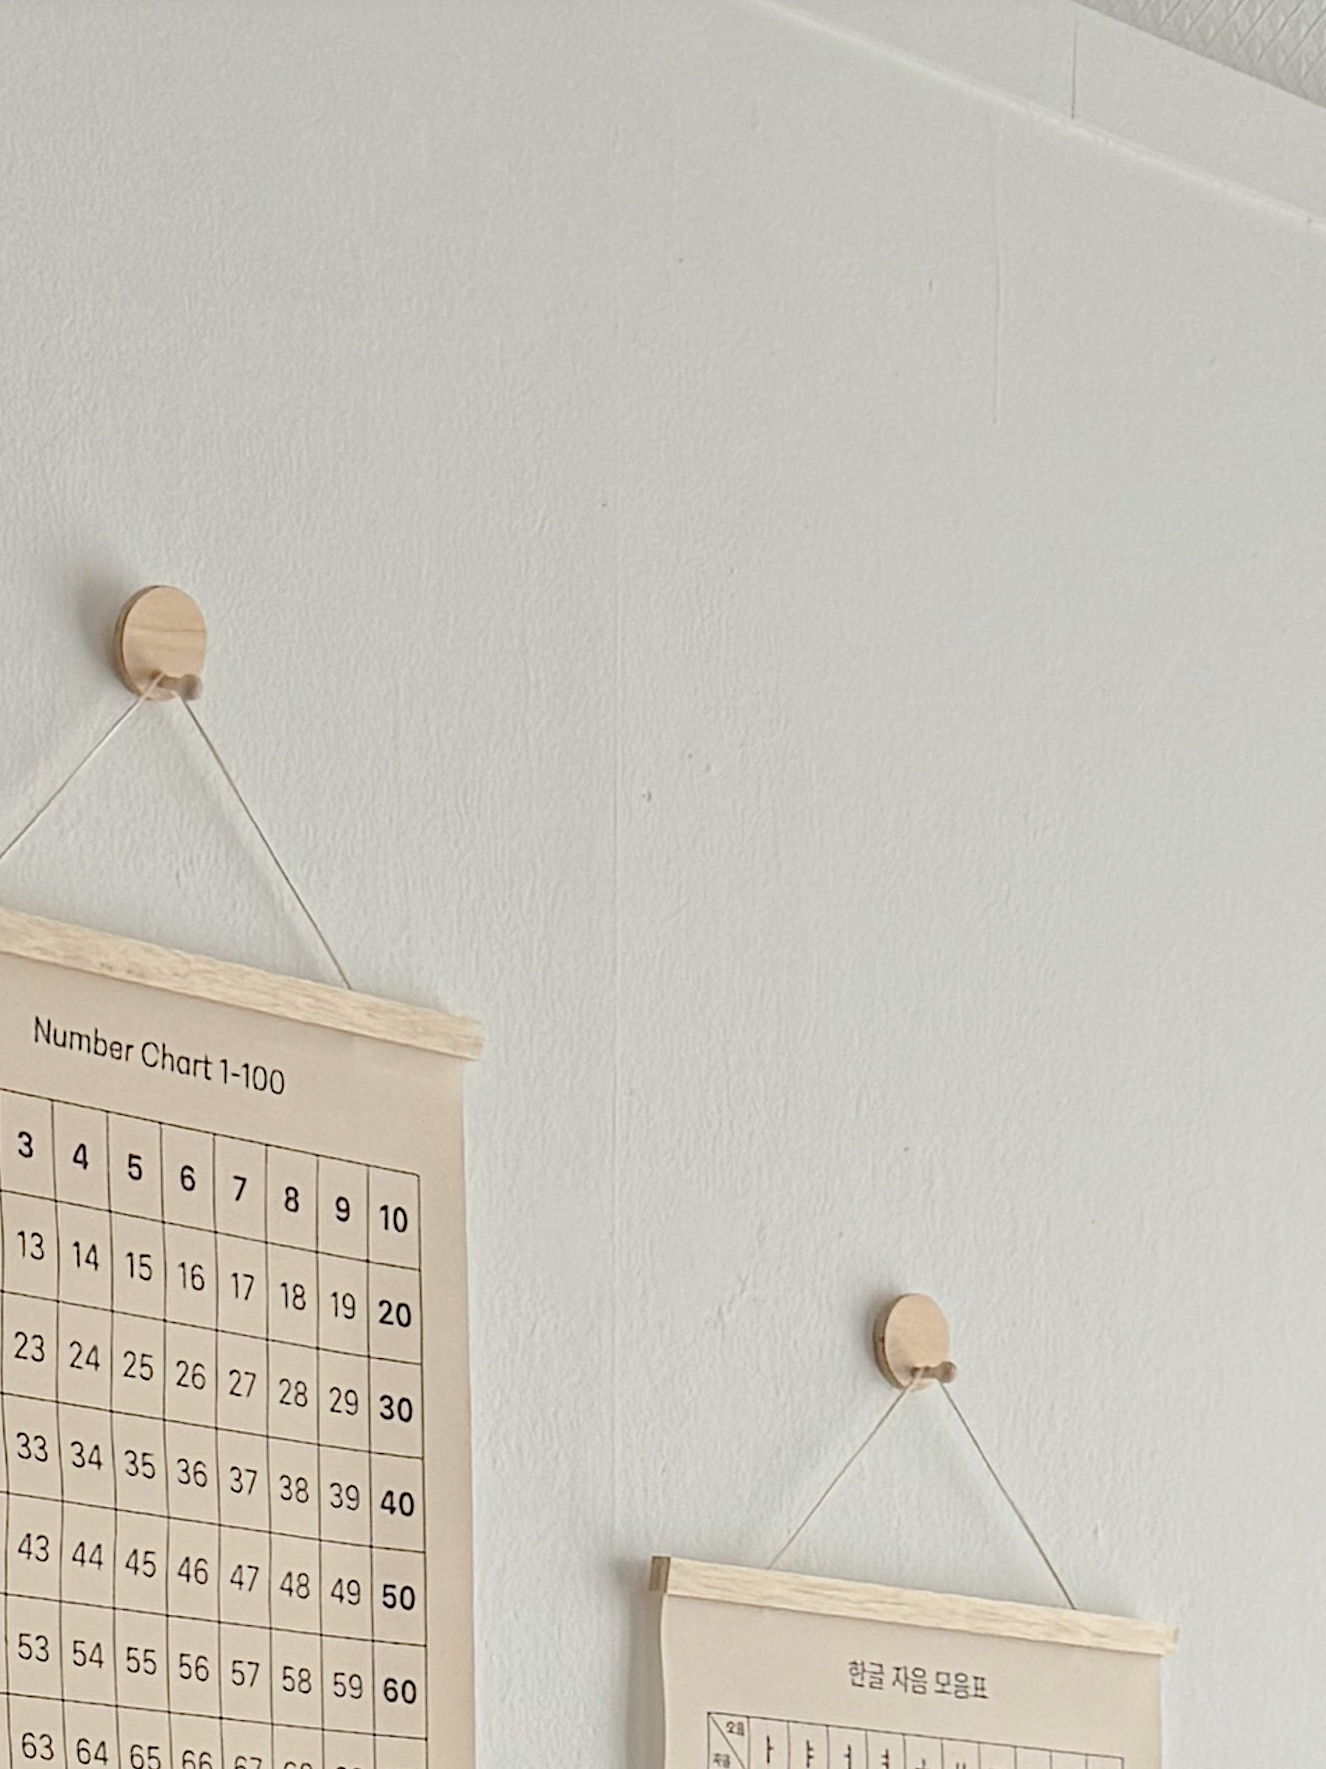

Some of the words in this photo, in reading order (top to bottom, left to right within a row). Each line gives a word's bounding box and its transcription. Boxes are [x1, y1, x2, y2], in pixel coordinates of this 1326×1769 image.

[33, 1015, 135, 1063] Number
[140, 1040, 213, 1082] Chart
[219, 1058, 286, 1096] 1-100
[17, 1130, 34, 1159] 3
[72, 1142, 89, 1171] 4
[127, 1152, 143, 1182] 5
[179, 1164, 197, 1192] 6
[232, 1174, 248, 1202] 7
[283, 1185, 300, 1214] 8
[334, 1195, 351, 1223] 9
[379, 1203, 409, 1234] 10
[16, 1229, 45, 1261] 13
[71, 1240, 100, 1272] 14
[125, 1251, 153, 1282] 15
[177, 1261, 206, 1292] 16
[230, 1271, 255, 1302] 17
[279, 1281, 307, 1311] 18
[330, 1291, 356, 1320] 19
[378, 1298, 412, 1329] 20
[16, 1431, 49, 1463] 33
[70, 1440, 104, 1471] 34
[123, 1449, 157, 1480] 35
[176, 1457, 209, 1489] 36
[229, 1465, 258, 1496] 37
[278, 1473, 310, 1504] 38
[329, 1481, 361, 1512] 39
[379, 1489, 415, 1518] 40
[17, 1632, 50, 1663] 53
[72, 1639, 105, 1669] 54
[126, 1645, 158, 1676] 55
[178, 1652, 210, 1683] 56
[231, 1659, 261, 1688] 57
[282, 1664, 313, 1695] 58
[332, 1671, 364, 1700] 59
[382, 1676, 417, 1705] 60
[847, 1659, 886, 1691] 한글
[891, 1665, 929, 1696] 자음
[933, 1670, 990, 1700] 모음표
